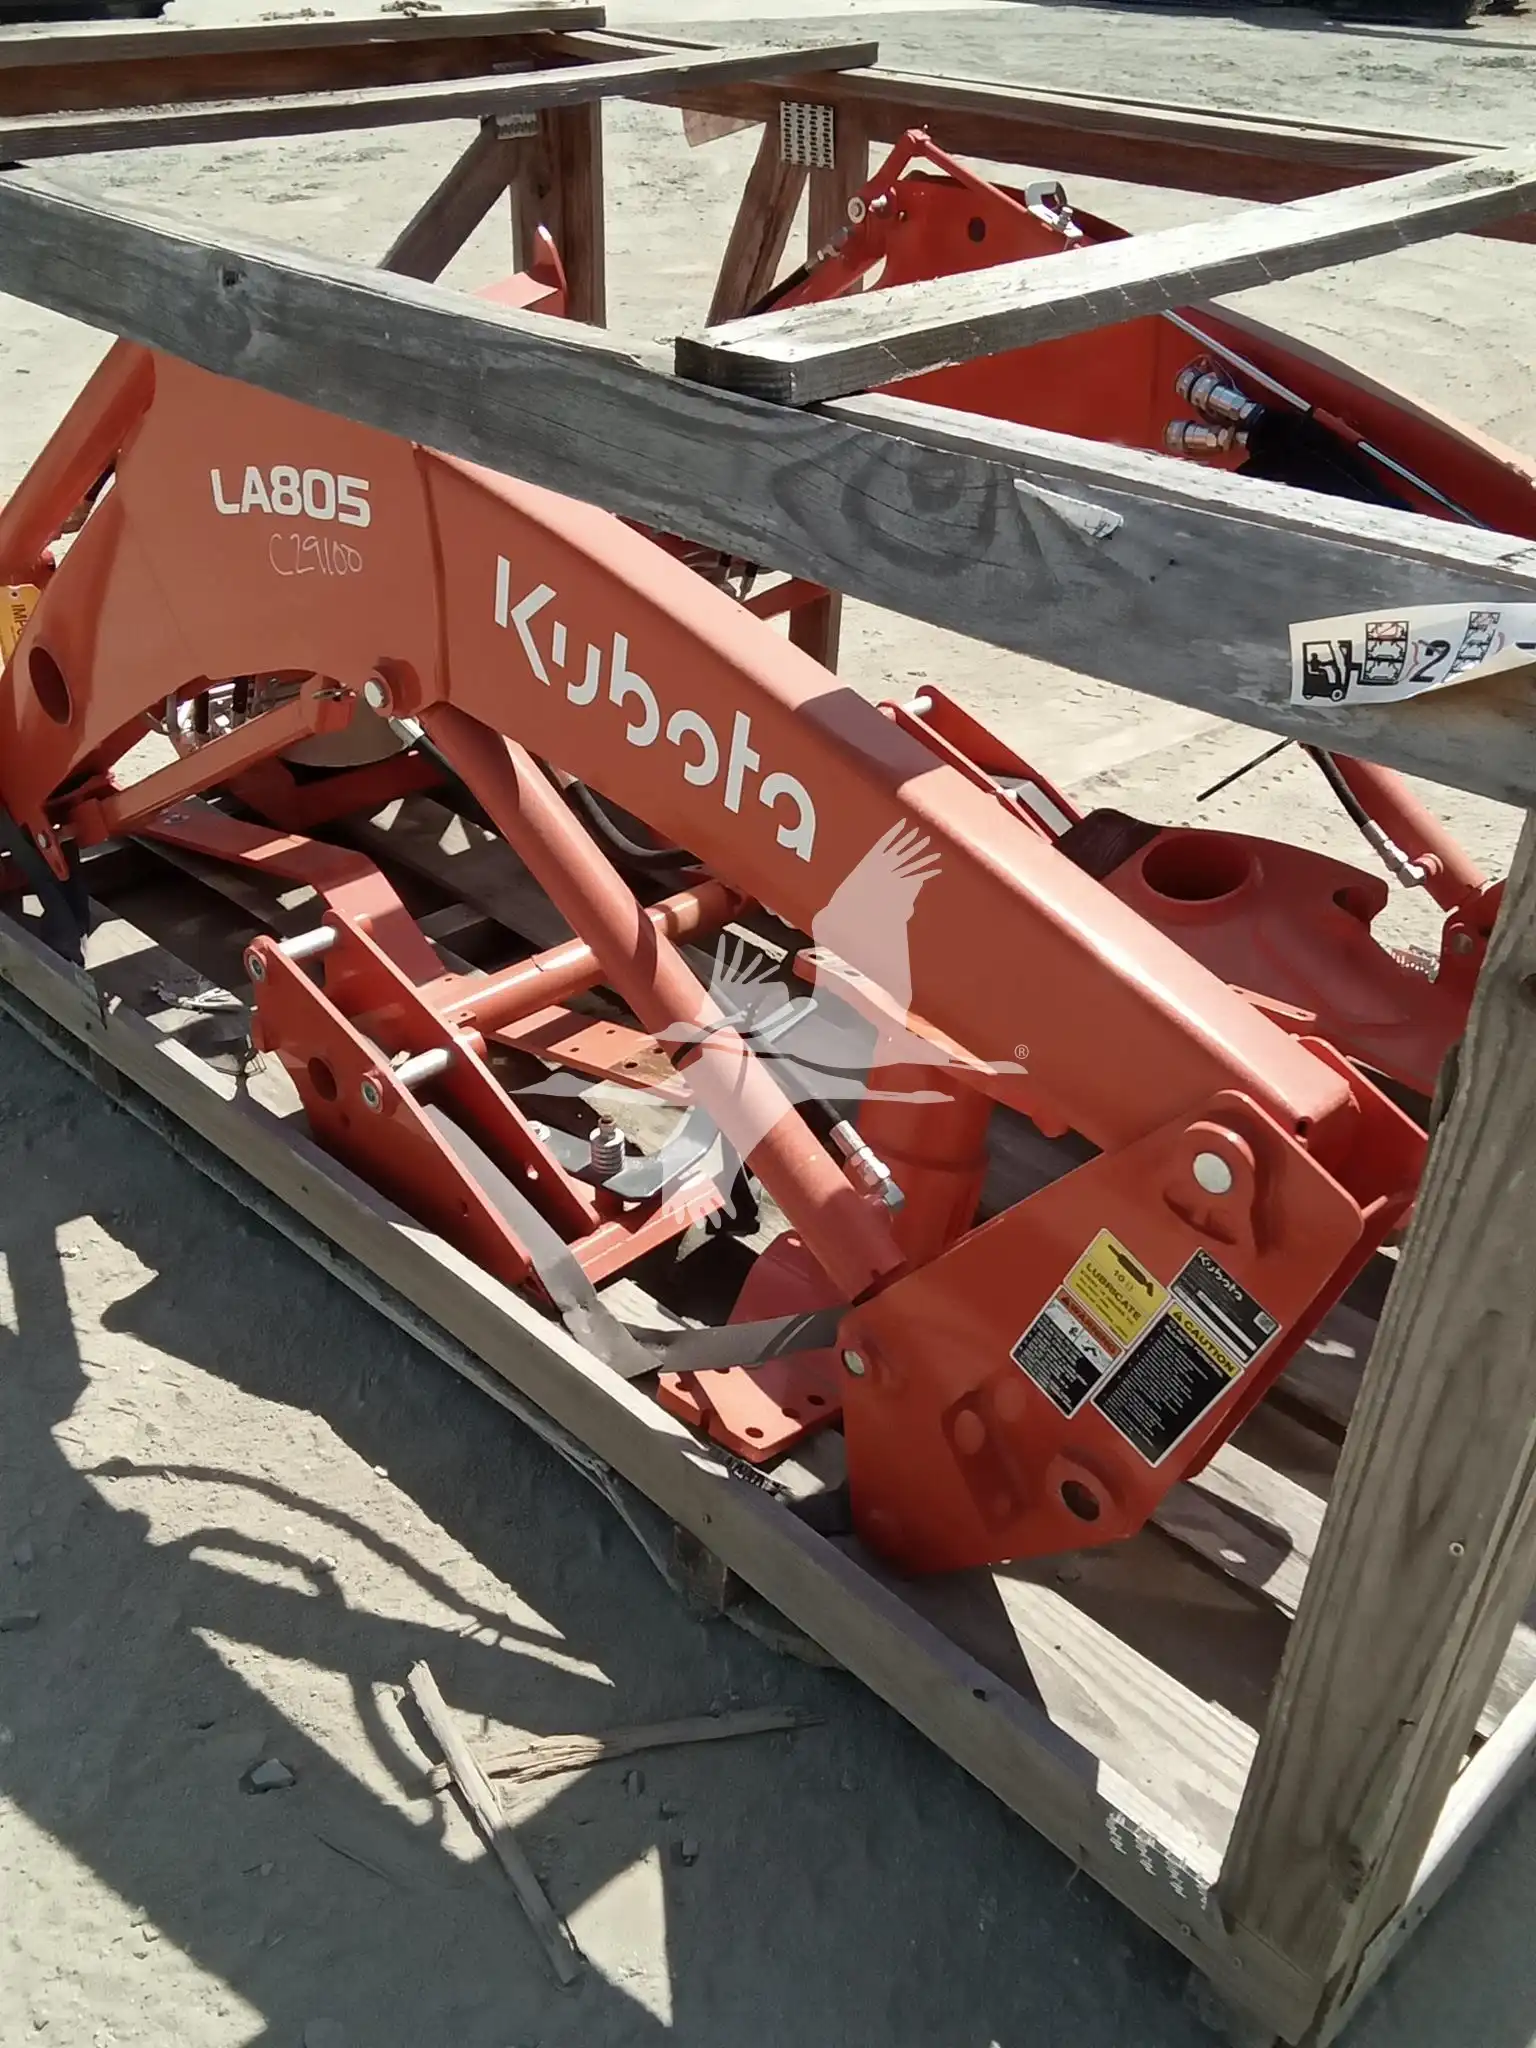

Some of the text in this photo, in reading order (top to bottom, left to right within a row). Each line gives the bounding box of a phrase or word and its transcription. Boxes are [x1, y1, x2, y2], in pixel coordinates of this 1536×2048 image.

[210, 465, 371, 528] LA805
[269, 533, 363, 576] C29100
[494, 554, 816, 862] Kubota
[1086, 1262, 1142, 1322] LUBRICATE
[1198, 1252, 1243, 1301] Kubota
[1184, 1320, 1236, 1373] CAUTION
